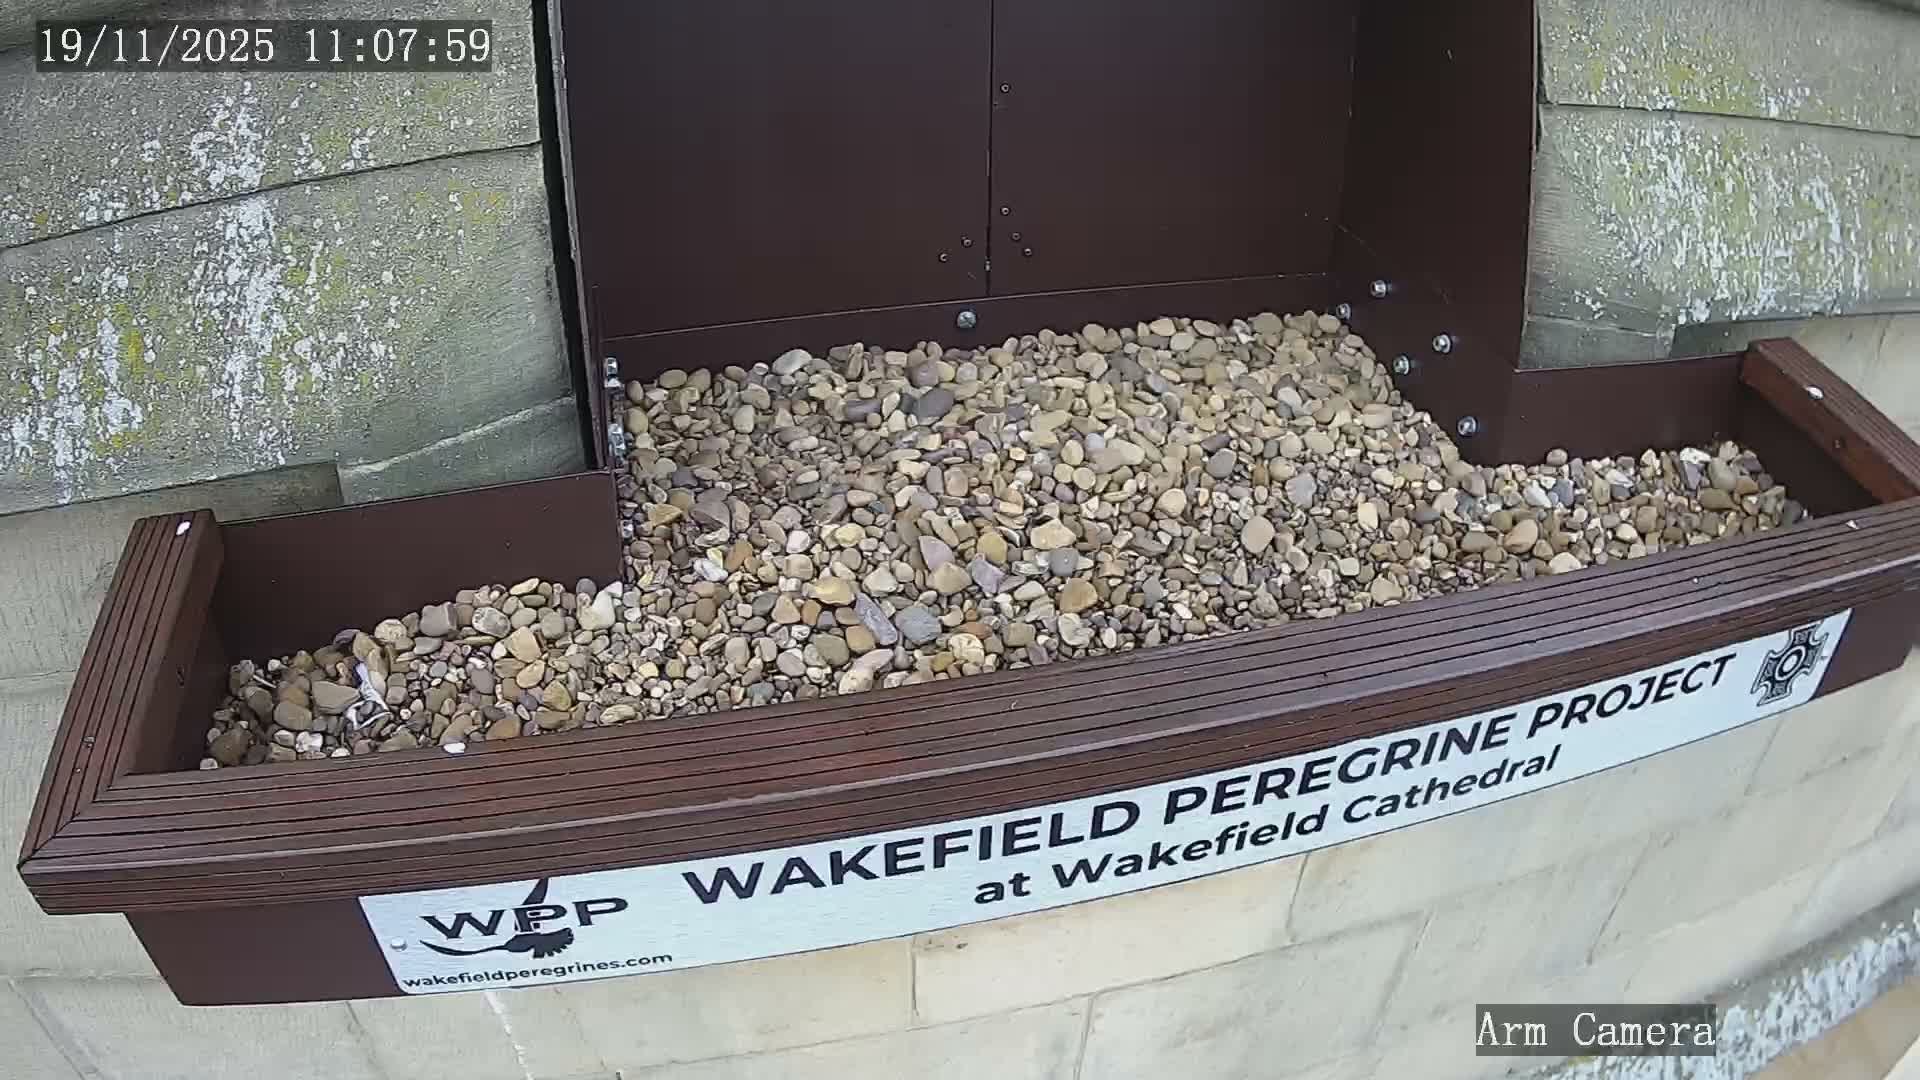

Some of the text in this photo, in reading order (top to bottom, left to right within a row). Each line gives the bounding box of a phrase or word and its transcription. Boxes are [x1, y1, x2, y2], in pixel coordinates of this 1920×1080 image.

[682, 653, 1735, 904] WAKEFIELD PEREGRINE PROJECT
[974, 744, 1561, 904] at Wakefield Cathedral
[420, 897, 628, 939] WPP
[403, 954, 672, 987] wakefieldperegrines.com
